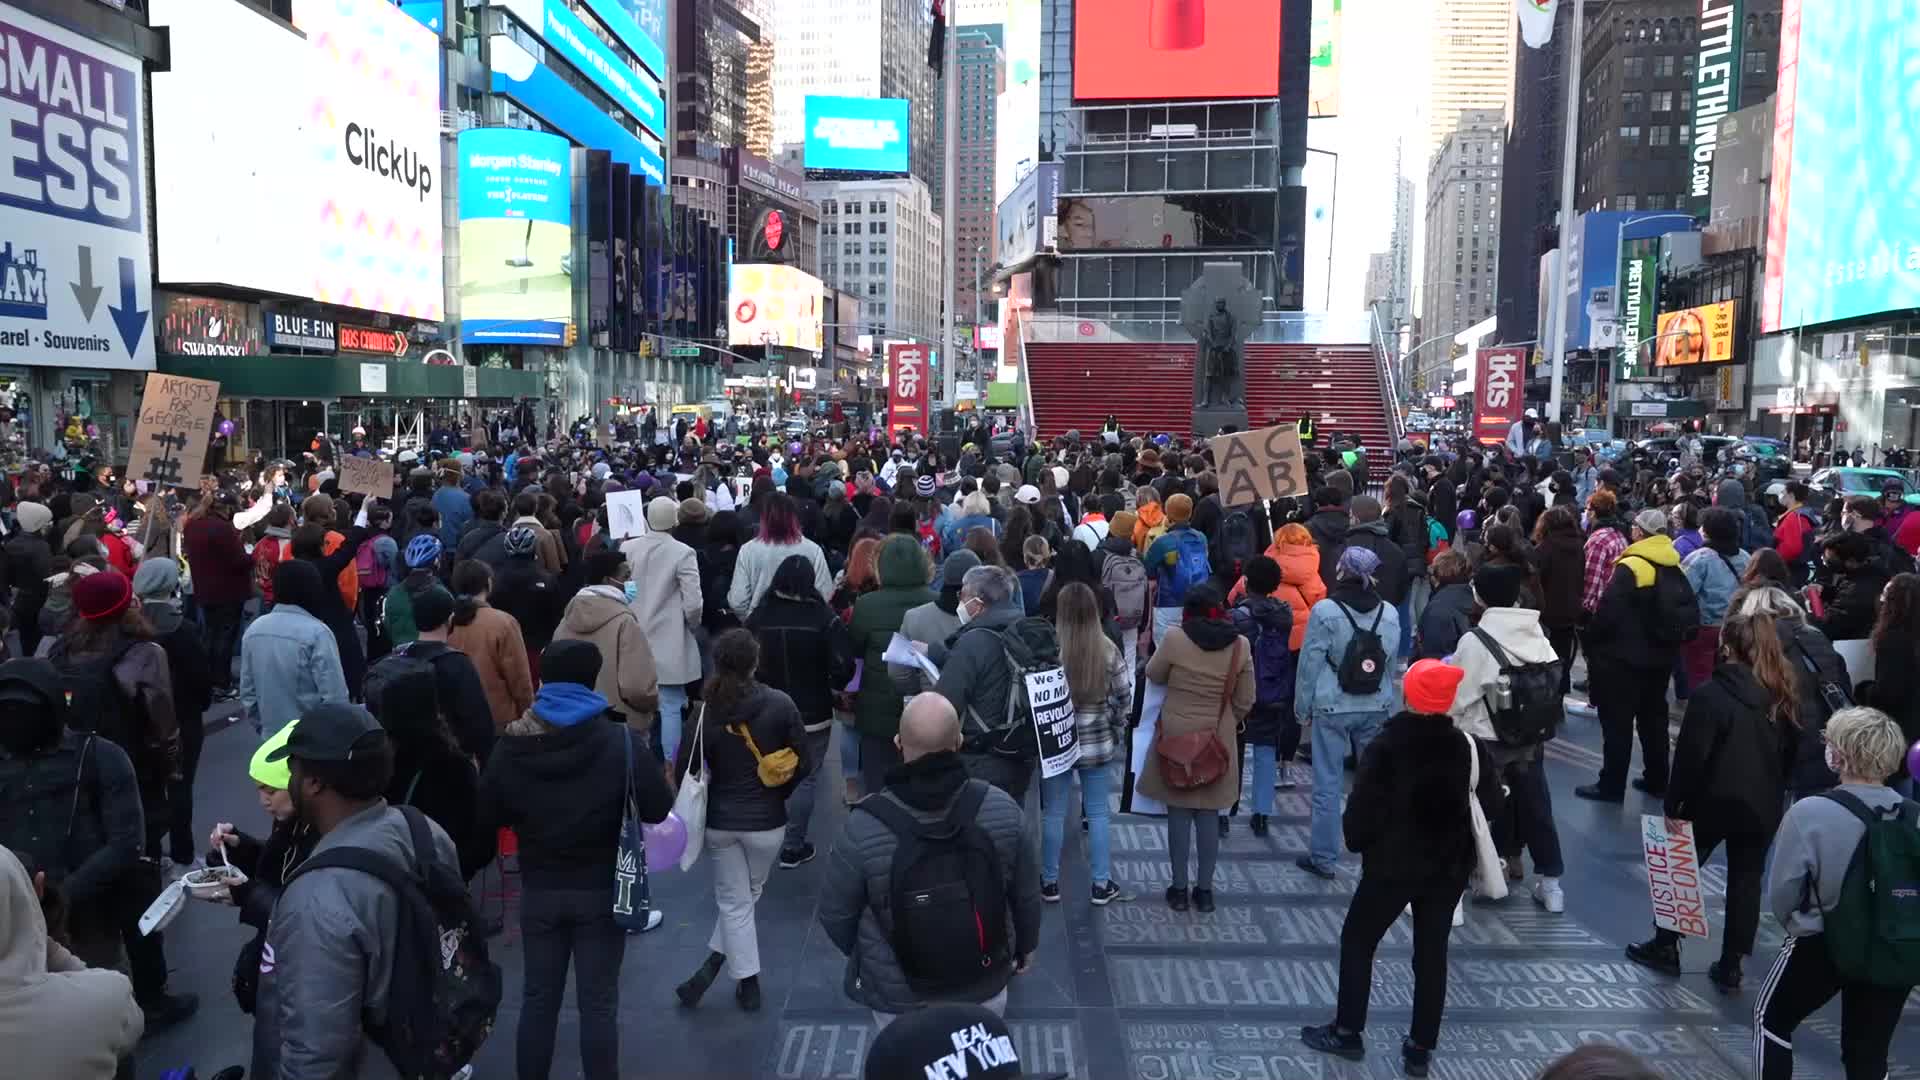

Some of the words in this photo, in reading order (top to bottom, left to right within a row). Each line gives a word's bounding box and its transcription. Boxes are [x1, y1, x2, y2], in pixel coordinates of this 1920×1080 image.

[0, 33, 128, 129] MALL
[344, 121, 432, 203] ClickUp
[275, 314, 308, 335] BLUE
[313, 319, 335, 339] FIN
[43, 329, 111, 353] Souvenirs
[897, 348, 922, 399] tkts
[1486, 353, 1517, 408] tkts
[160, 378, 213, 402] ARTISTS
[142, 407, 206, 431] GEORGE
[169, 397, 193, 417] FOR
[1034, 674, 1054, 685] We
[1034, 689, 1051, 704] NO
[1645, 842, 1678, 926] JUSTICE
